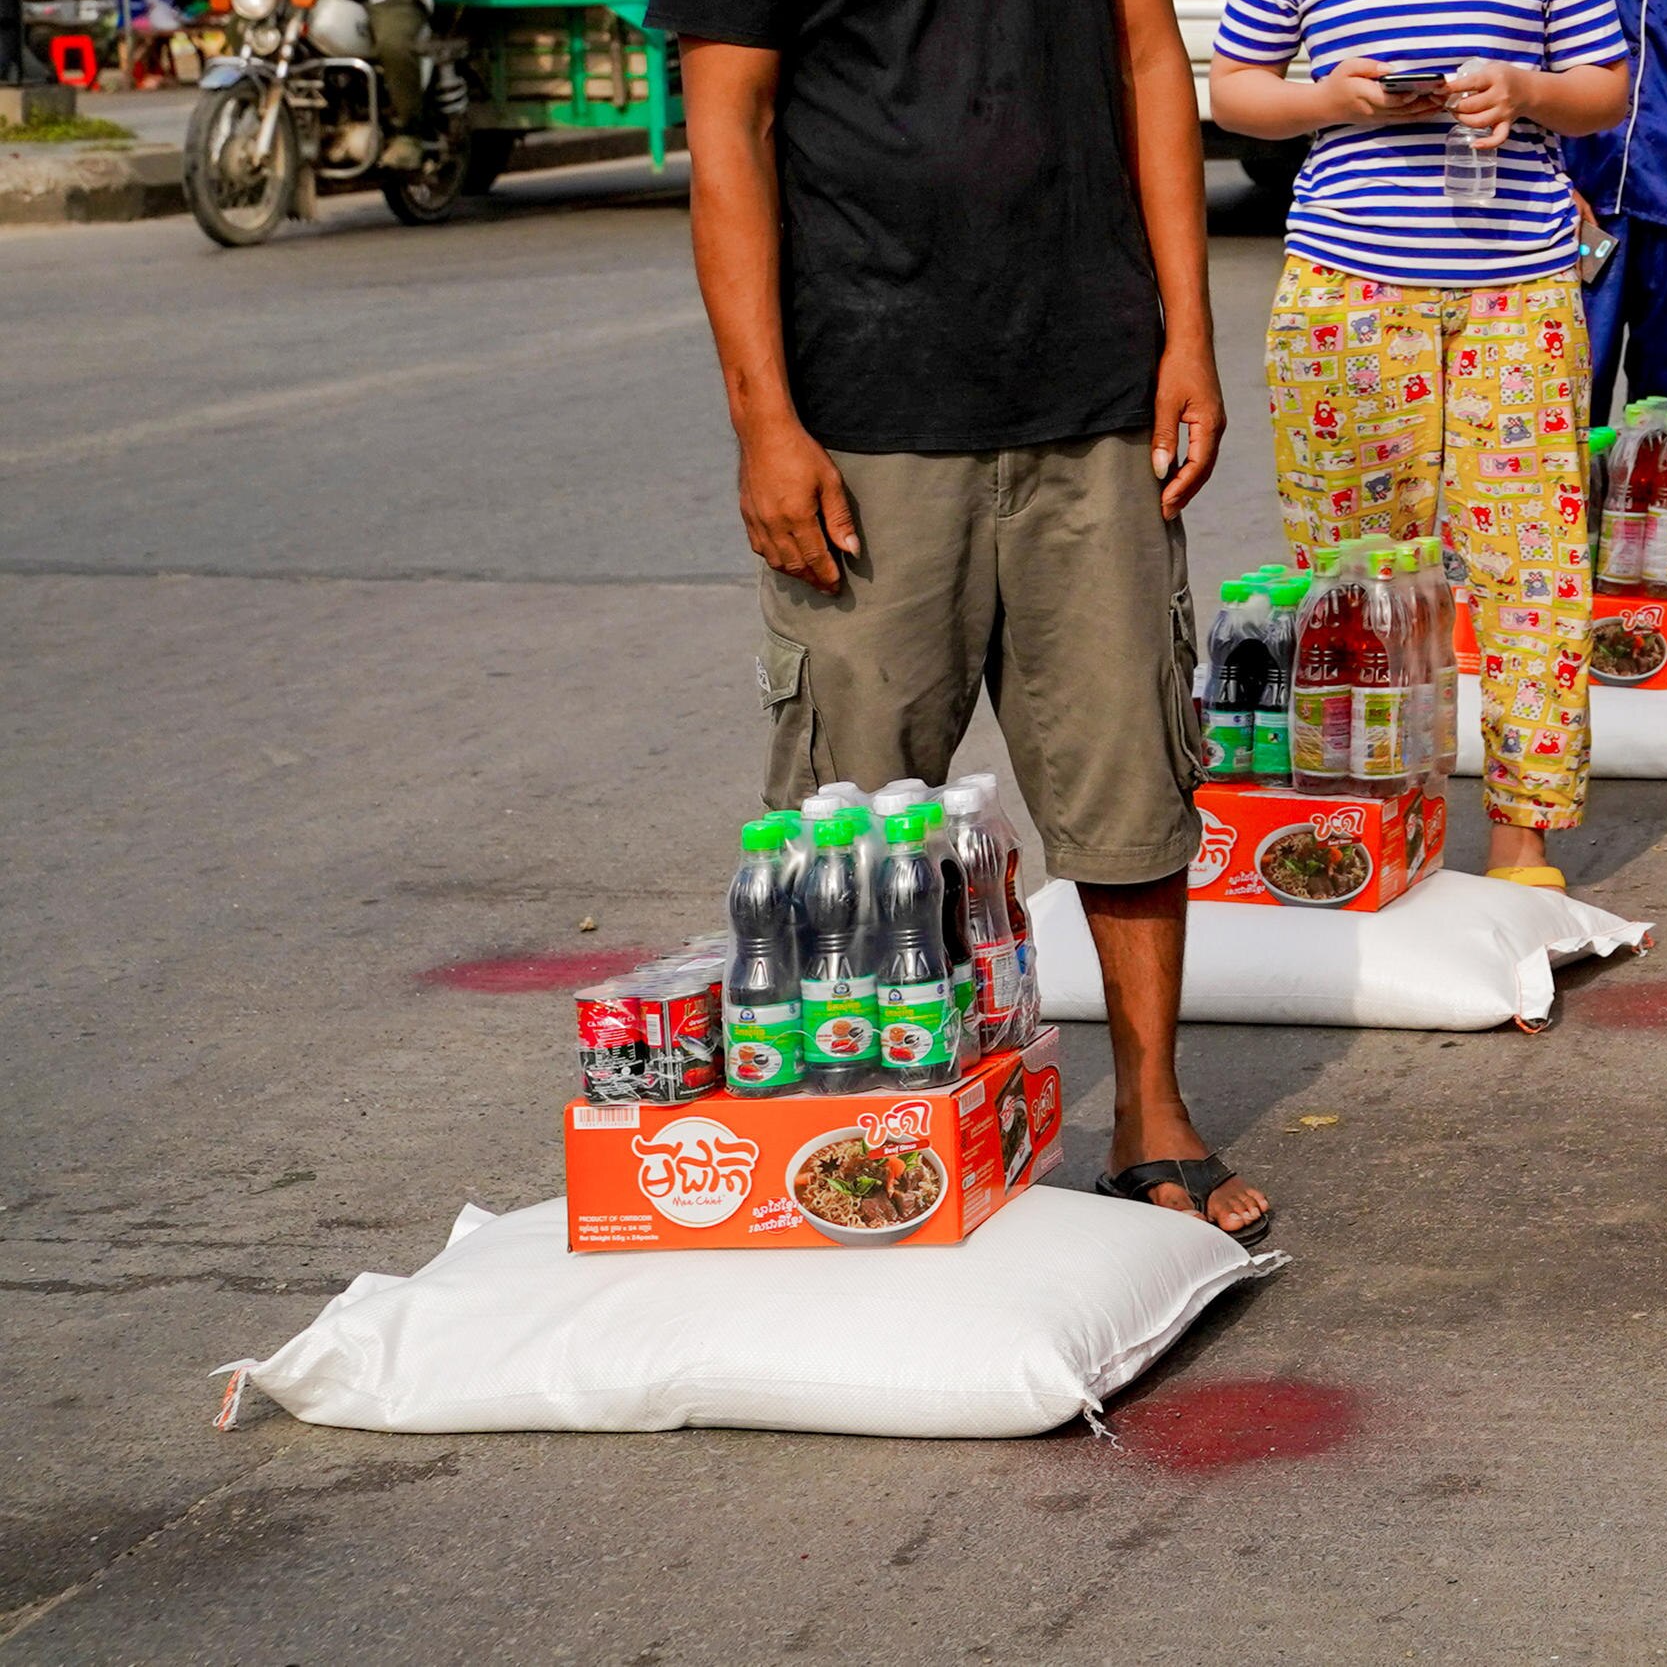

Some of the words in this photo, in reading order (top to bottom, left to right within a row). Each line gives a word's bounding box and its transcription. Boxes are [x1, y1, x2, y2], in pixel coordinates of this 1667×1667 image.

[857, 1099, 932, 1147] ខគោ
[633, 1134, 760, 1198] មីជាតិ
